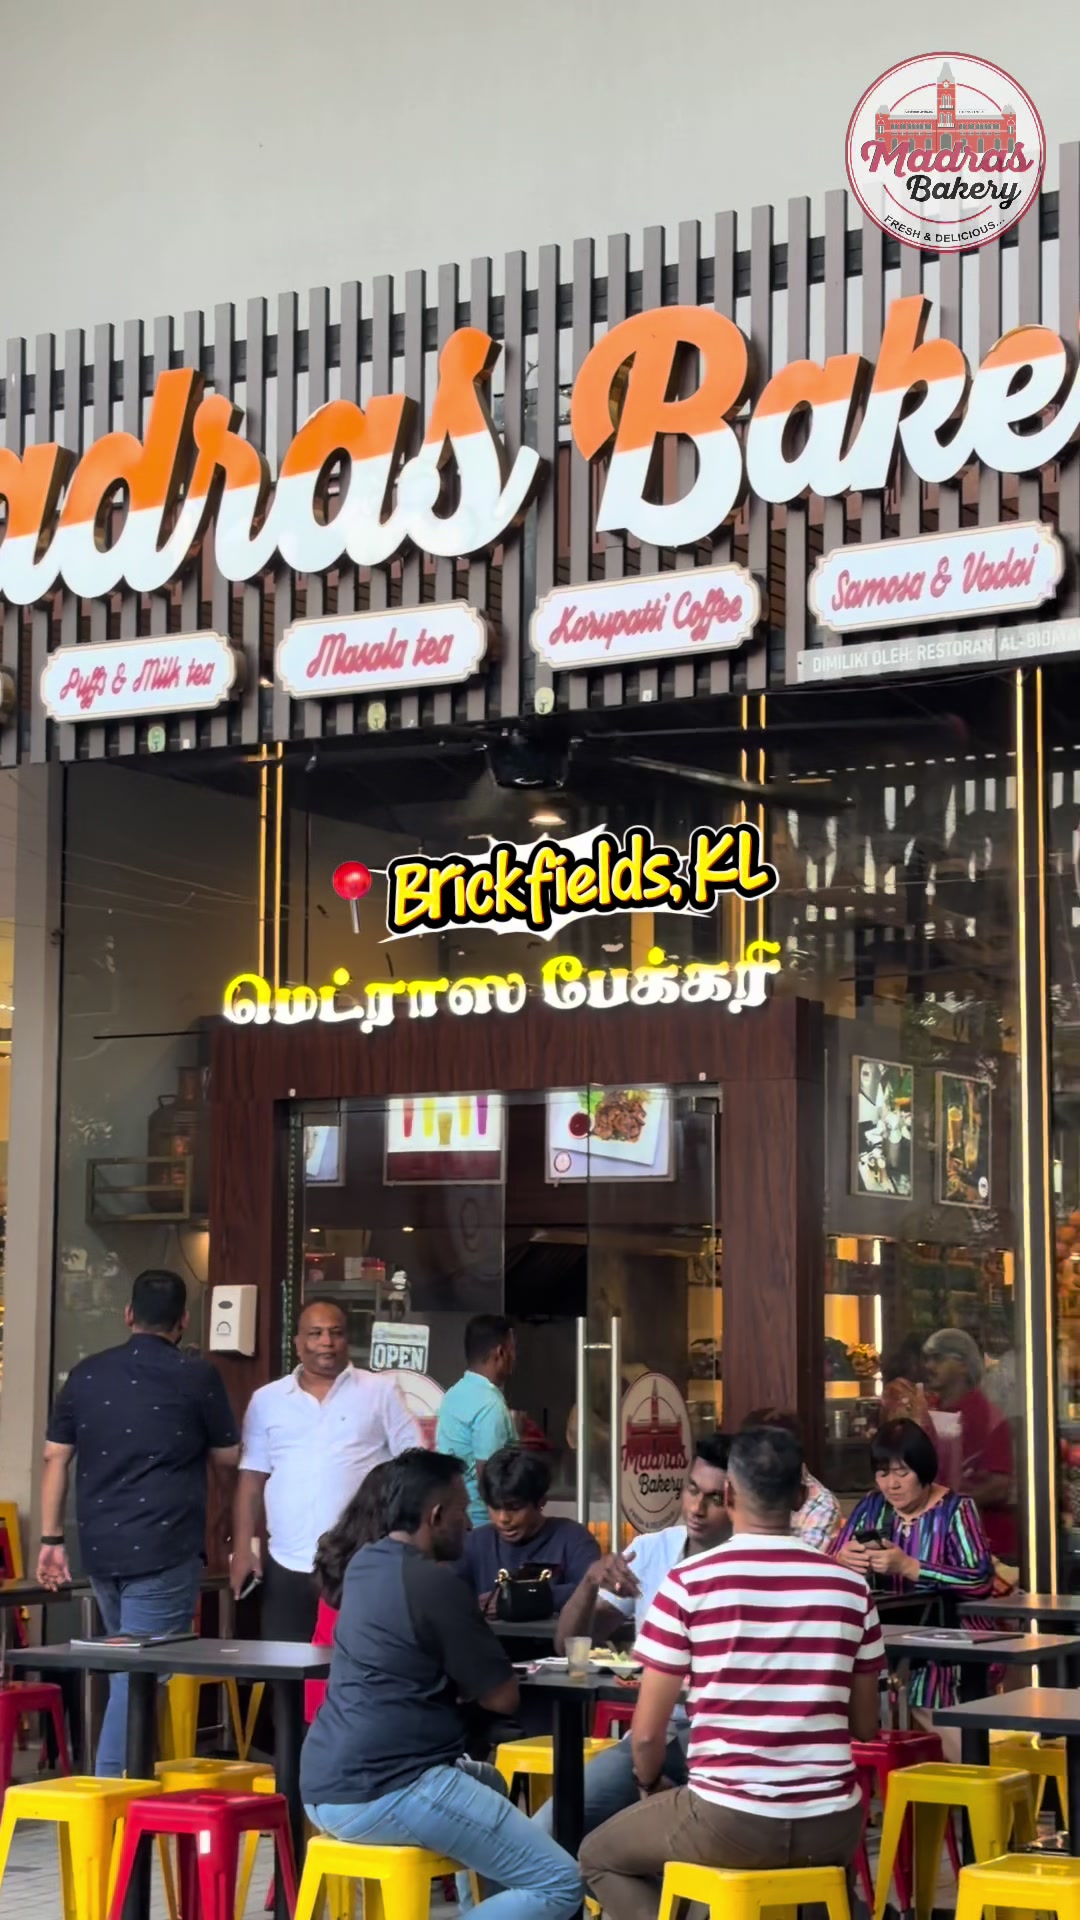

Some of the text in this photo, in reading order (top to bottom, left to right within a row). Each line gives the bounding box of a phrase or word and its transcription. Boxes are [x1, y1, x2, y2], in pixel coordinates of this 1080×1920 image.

[831, 542, 1040, 612] Samosa & Vadai
[548, 586, 743, 651] Karupatti Coffee
[111, 662, 127, 695] &
[132, 655, 181, 693] Milk
[185, 657, 216, 688] tea
[306, 627, 455, 679] Masala tea
[812, 651, 869, 674] DIMILIKI
[917, 638, 994, 662] RESTORAN
[541, 940, 782, 1015] பேக்கரி
[373, 1343, 425, 1372] OPEN
[638, 1472, 684, 1500] Bakery
